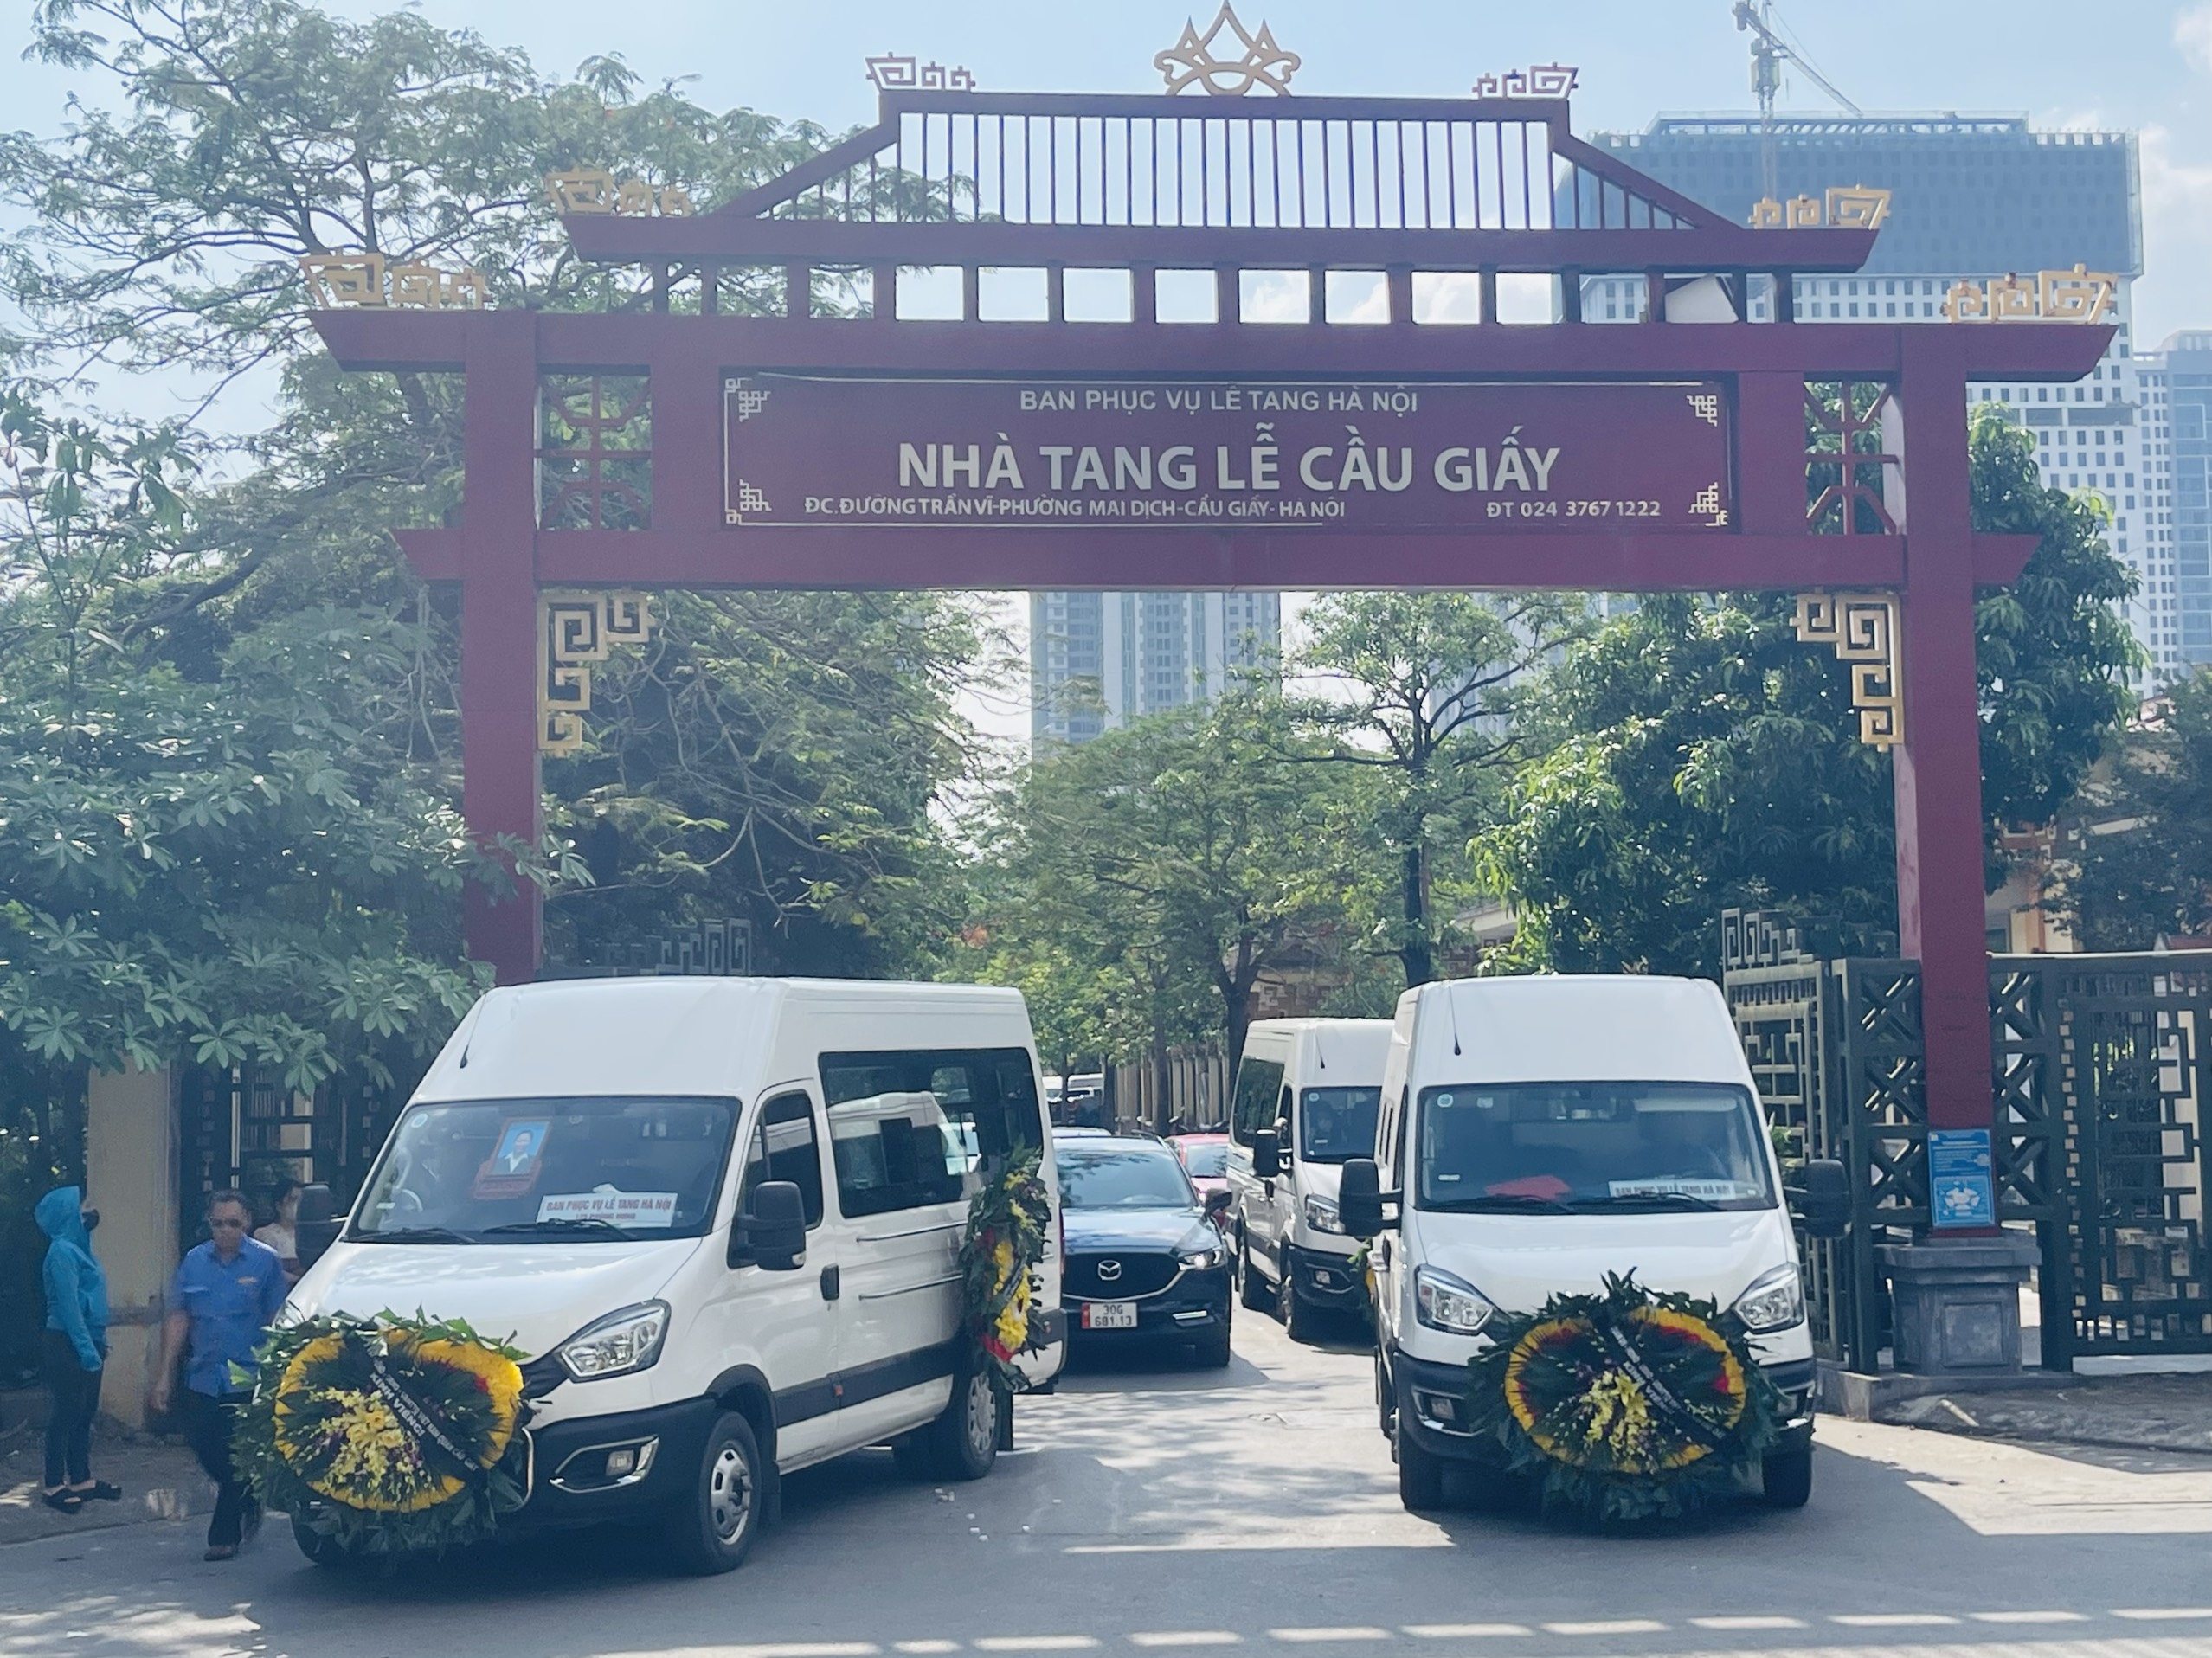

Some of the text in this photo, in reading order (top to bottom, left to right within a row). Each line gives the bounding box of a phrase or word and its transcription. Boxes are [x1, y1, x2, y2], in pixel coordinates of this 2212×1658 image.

[1020, 389, 1076, 411] BAN
[1085, 389, 1157, 416] PHỤC
[1165, 389, 1201, 416] VỤ
[1247, 390, 1320, 411] TANG
[1328, 385, 1365, 411] HÀ
[1373, 383, 1418, 418] NỘI
[899, 422, 1561, 492] NHÀ TANG LỄ CẦU GIẤY
[917, 492, 972, 516] TRẦN
[1089, 499, 1126, 517] MAI
[1486, 500, 1662, 517] ĐT 024 3767 1222
[1103, 1304, 1123, 1314] 30G
